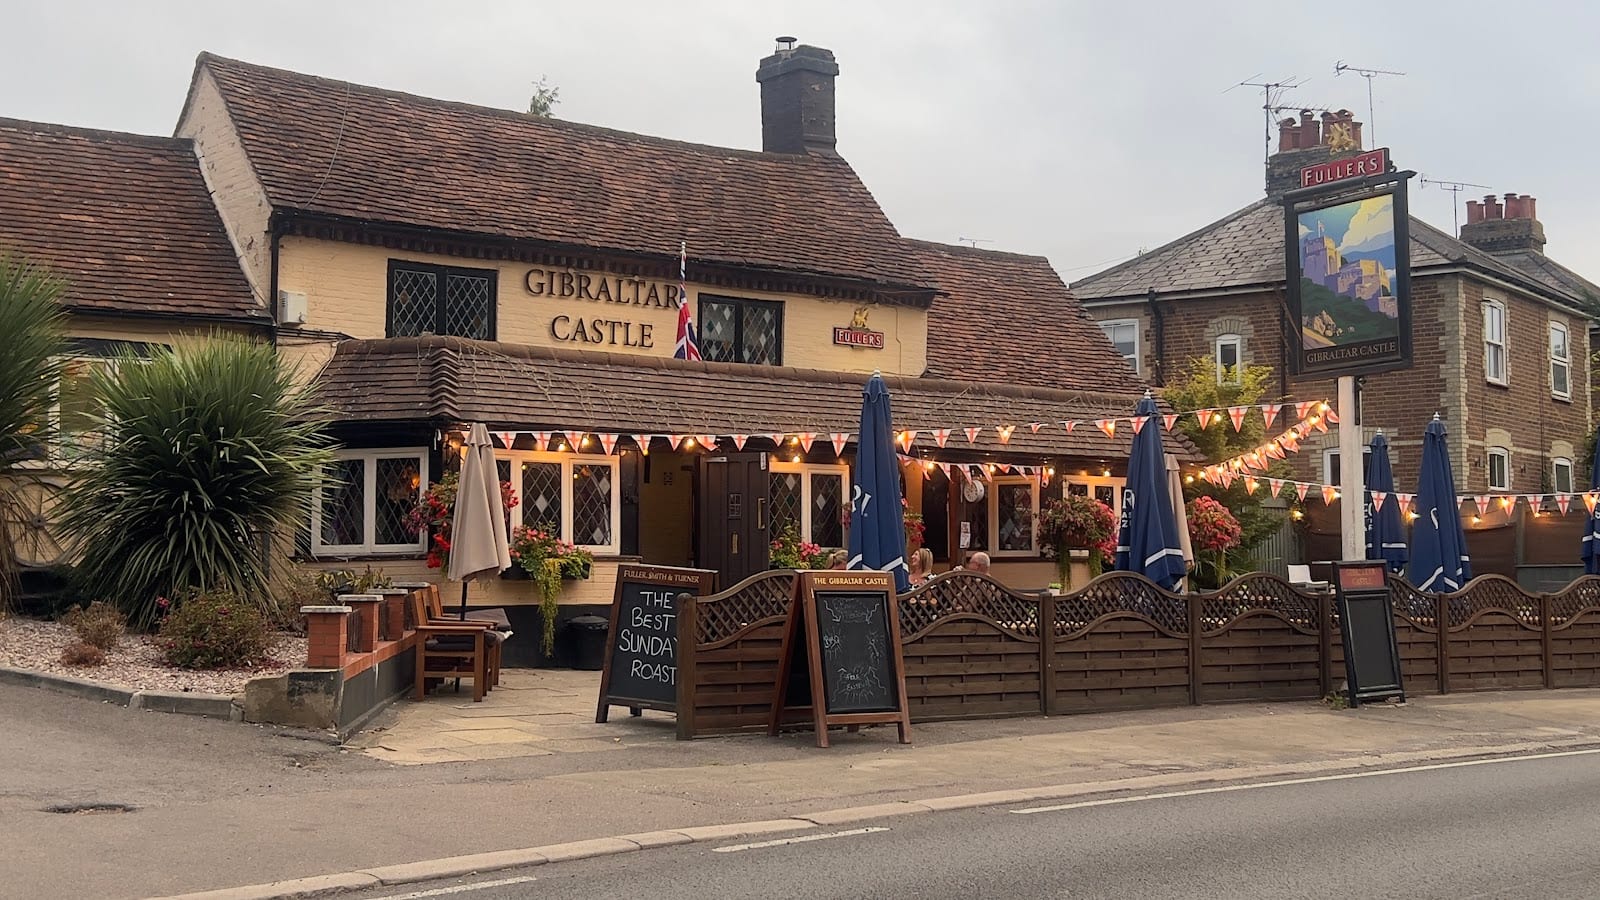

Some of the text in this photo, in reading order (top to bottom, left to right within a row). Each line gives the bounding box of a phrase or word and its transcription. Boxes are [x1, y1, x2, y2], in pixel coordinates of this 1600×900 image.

[1305, 157, 1377, 186] FULLER'S
[525, 268, 680, 309] GIBRALTAR
[551, 315, 653, 348] CASTLE
[1306, 341, 1396, 363] GIBRALTAR CASTLE
[667, 573, 673, 581] &
[674, 574, 700, 583] TURNER
[814, 577, 888, 585] THE GIBRALTAR CASTLE
[640, 591, 674, 609] THE
[631, 606, 676, 632] BEST
[619, 628, 678, 658] SUNDA
[631, 659, 677, 686] ROAST
